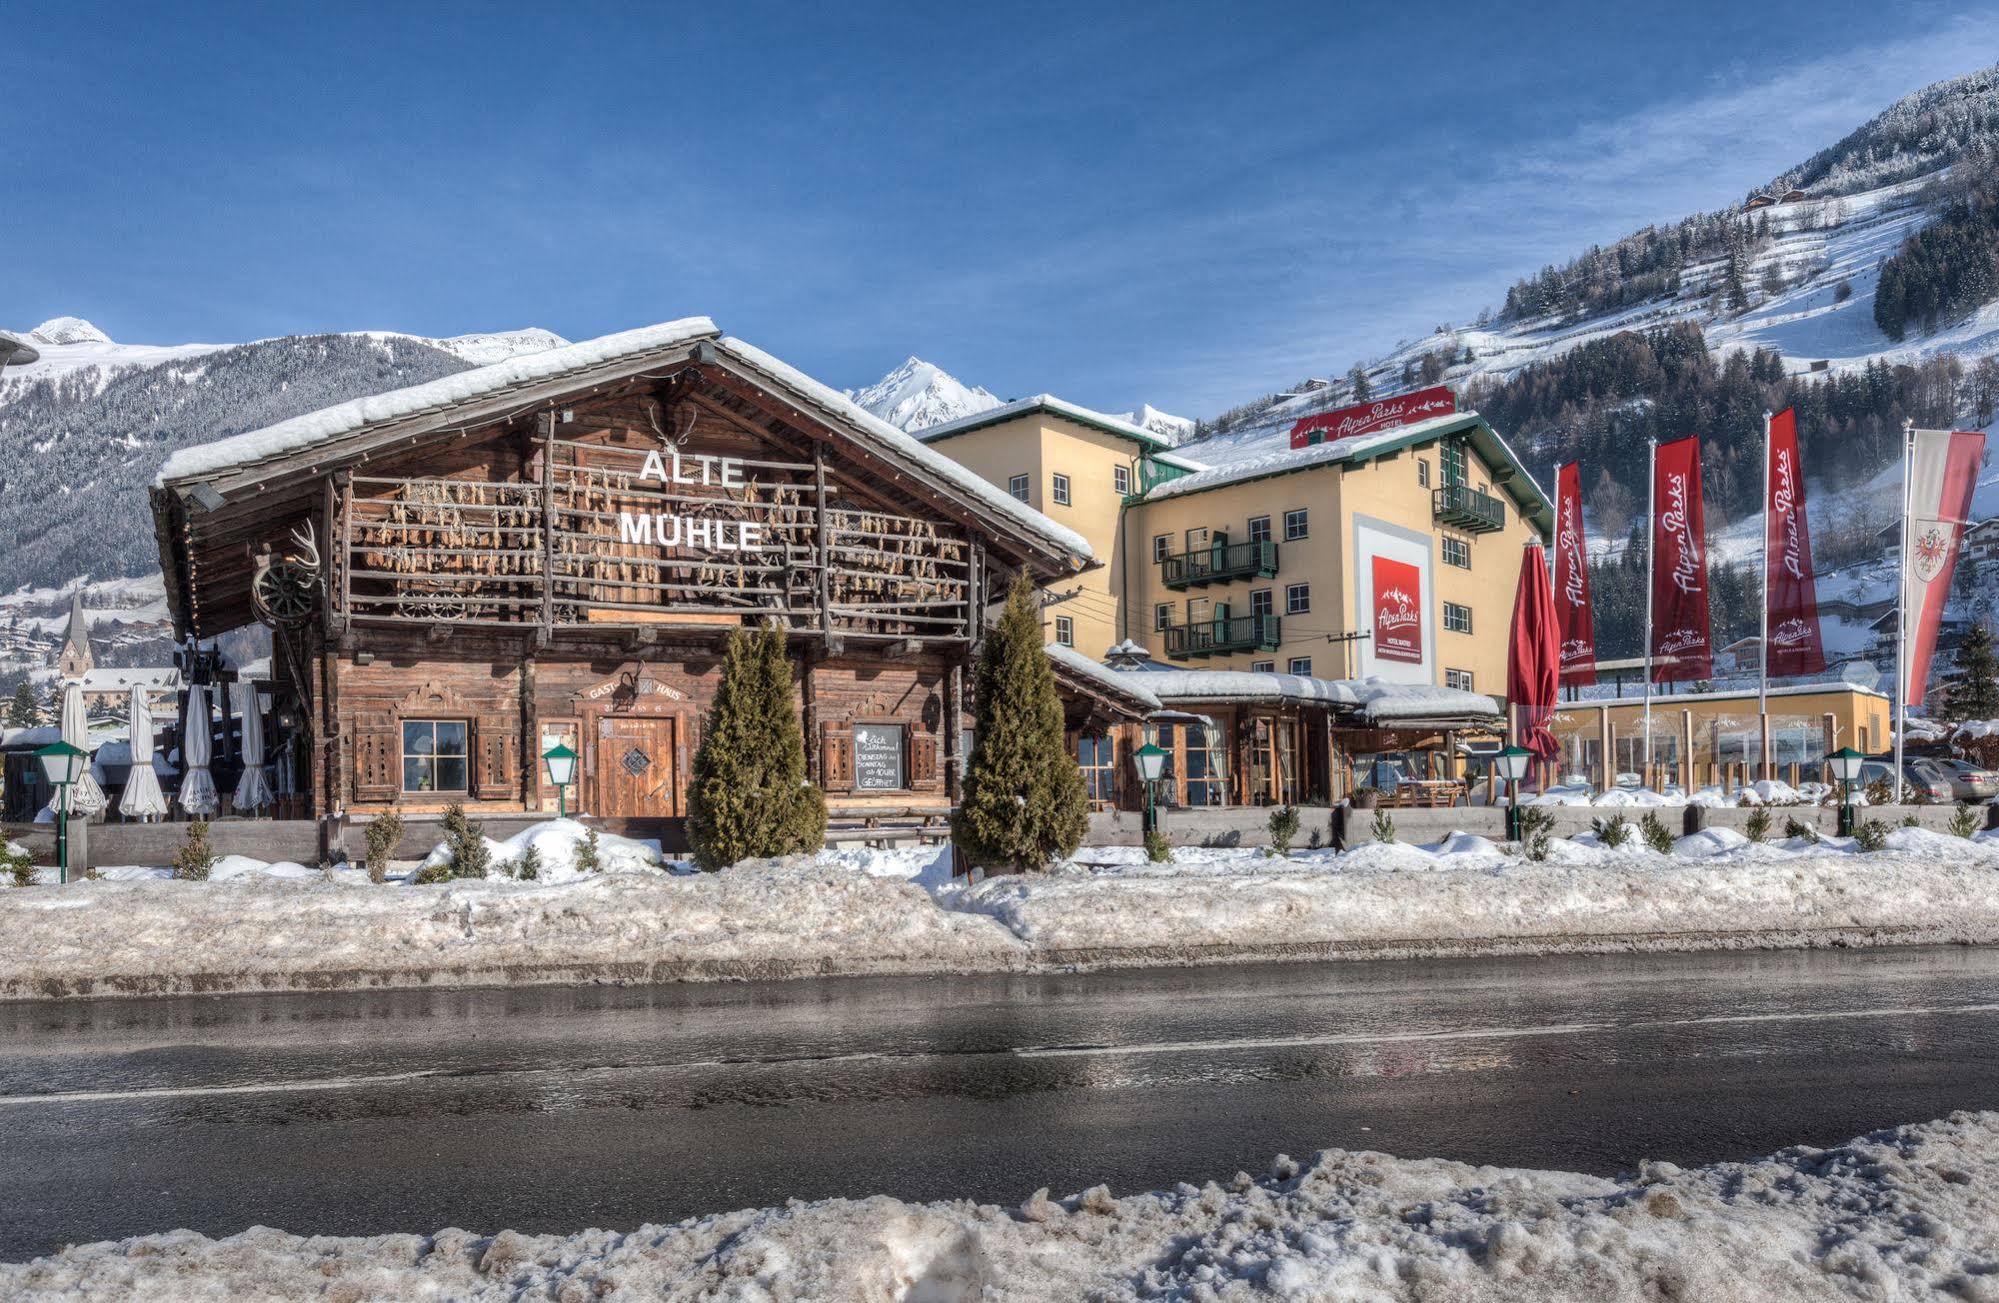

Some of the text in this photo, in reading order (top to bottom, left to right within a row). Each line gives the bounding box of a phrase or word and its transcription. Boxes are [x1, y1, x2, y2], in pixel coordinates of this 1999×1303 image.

[638, 449, 744, 488] ALTE
[620, 512, 762, 550] MÜHLE
[656, 683, 681, 700] HAUS
